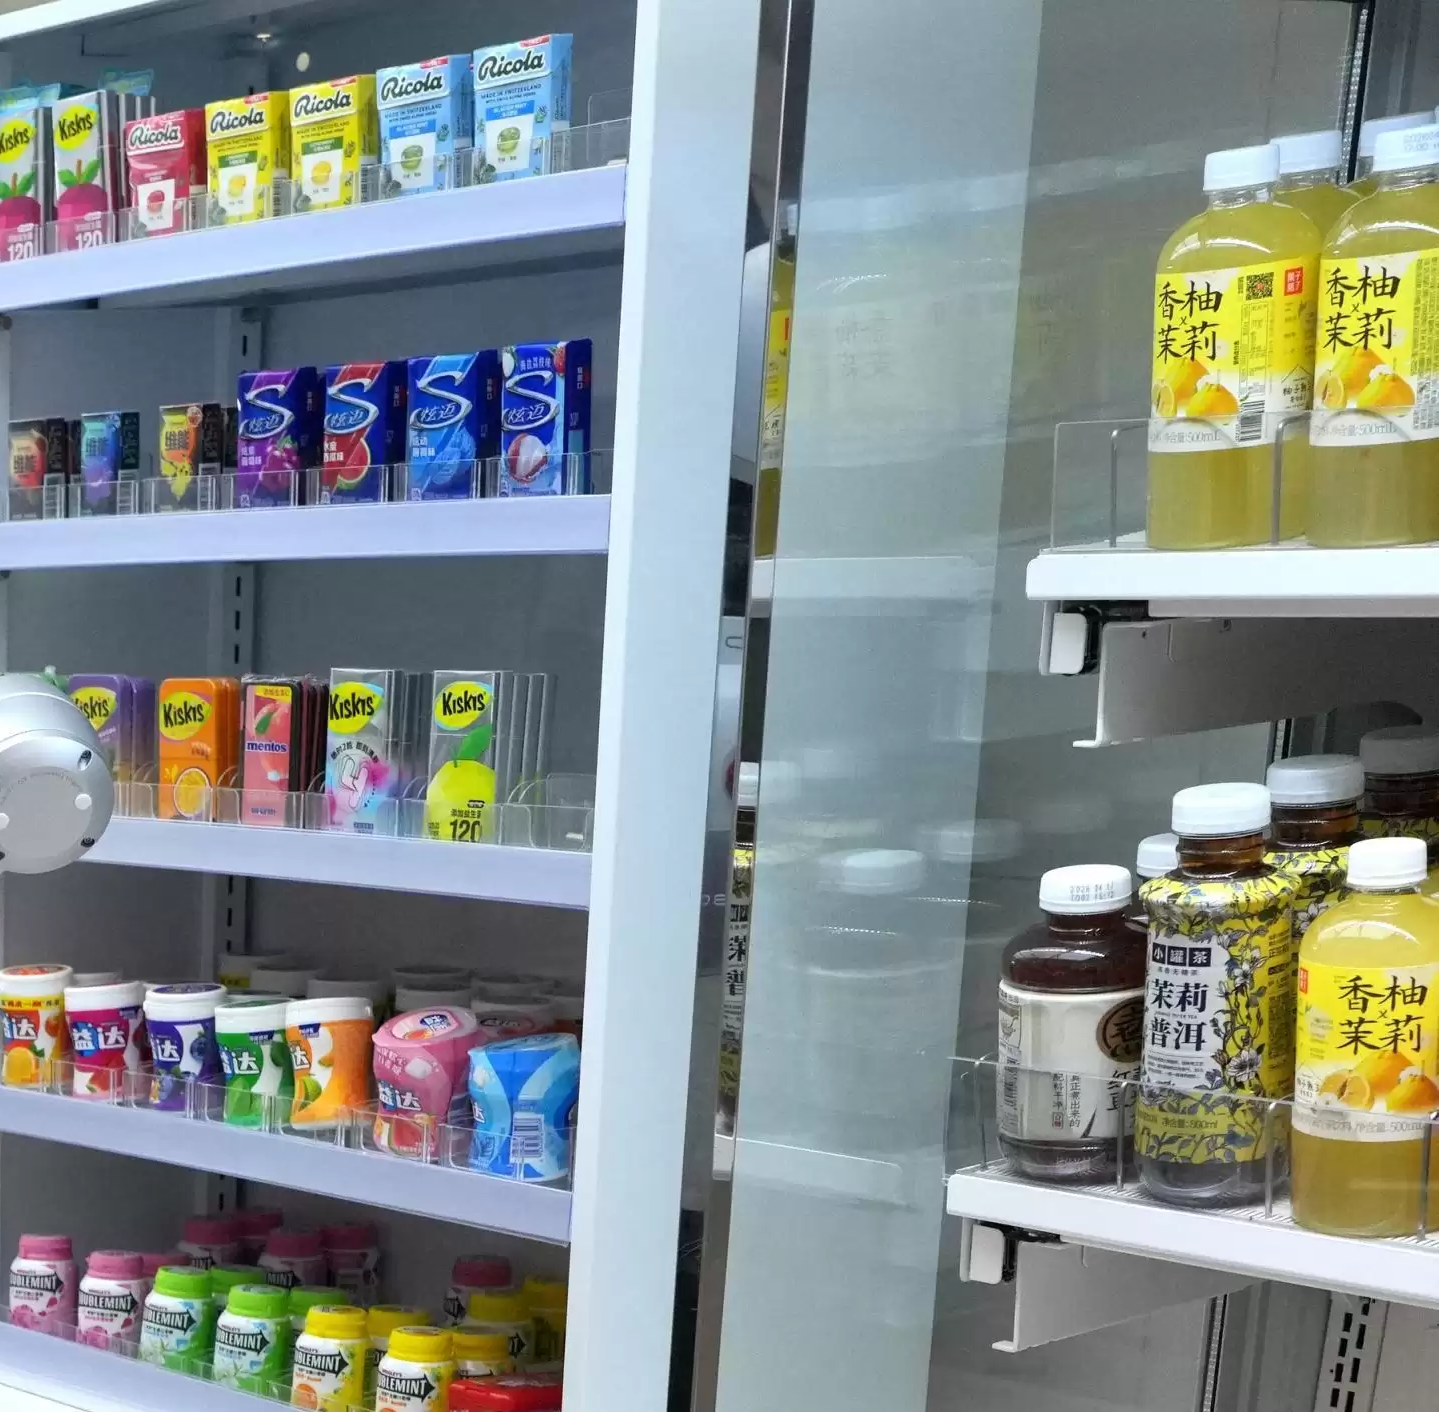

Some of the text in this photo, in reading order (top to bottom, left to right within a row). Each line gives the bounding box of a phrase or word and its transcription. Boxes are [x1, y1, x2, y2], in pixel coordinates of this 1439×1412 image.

[478, 50, 545, 82] Ricola
[381, 72, 444, 102] Ricola
[294, 90, 352, 118] Ricola
[130, 123, 180, 149] Ricola
[211, 108, 265, 134] Ricola
[1157, 280, 1223, 322] 香柚
[1325, 265, 1401, 308] 香柚
[1156, 320, 1220, 364] 茉莉
[1323, 307, 1396, 353] 茉莉
[248, 412, 283, 433] 炫迈
[330, 409, 363, 429] 炫迈
[421, 403, 456, 422] 炫迈
[507, 402, 545, 423] 炫迈
[247, 741, 287, 753] mentos
[449, 819, 482, 843] 120
[1153, 945, 1209, 965] 小罐茶
[1151, 977, 1209, 1013] 茉莉
[1338, 974, 1428, 1014] 香柚
[73, 1021, 127, 1051] 益达
[1151, 1016, 1208, 1052] 普洱
[1336, 1014, 1424, 1056] 茉莉
[377, 1080, 422, 1112] 益达
[378, 1373, 428, 1396] BLEMINT
